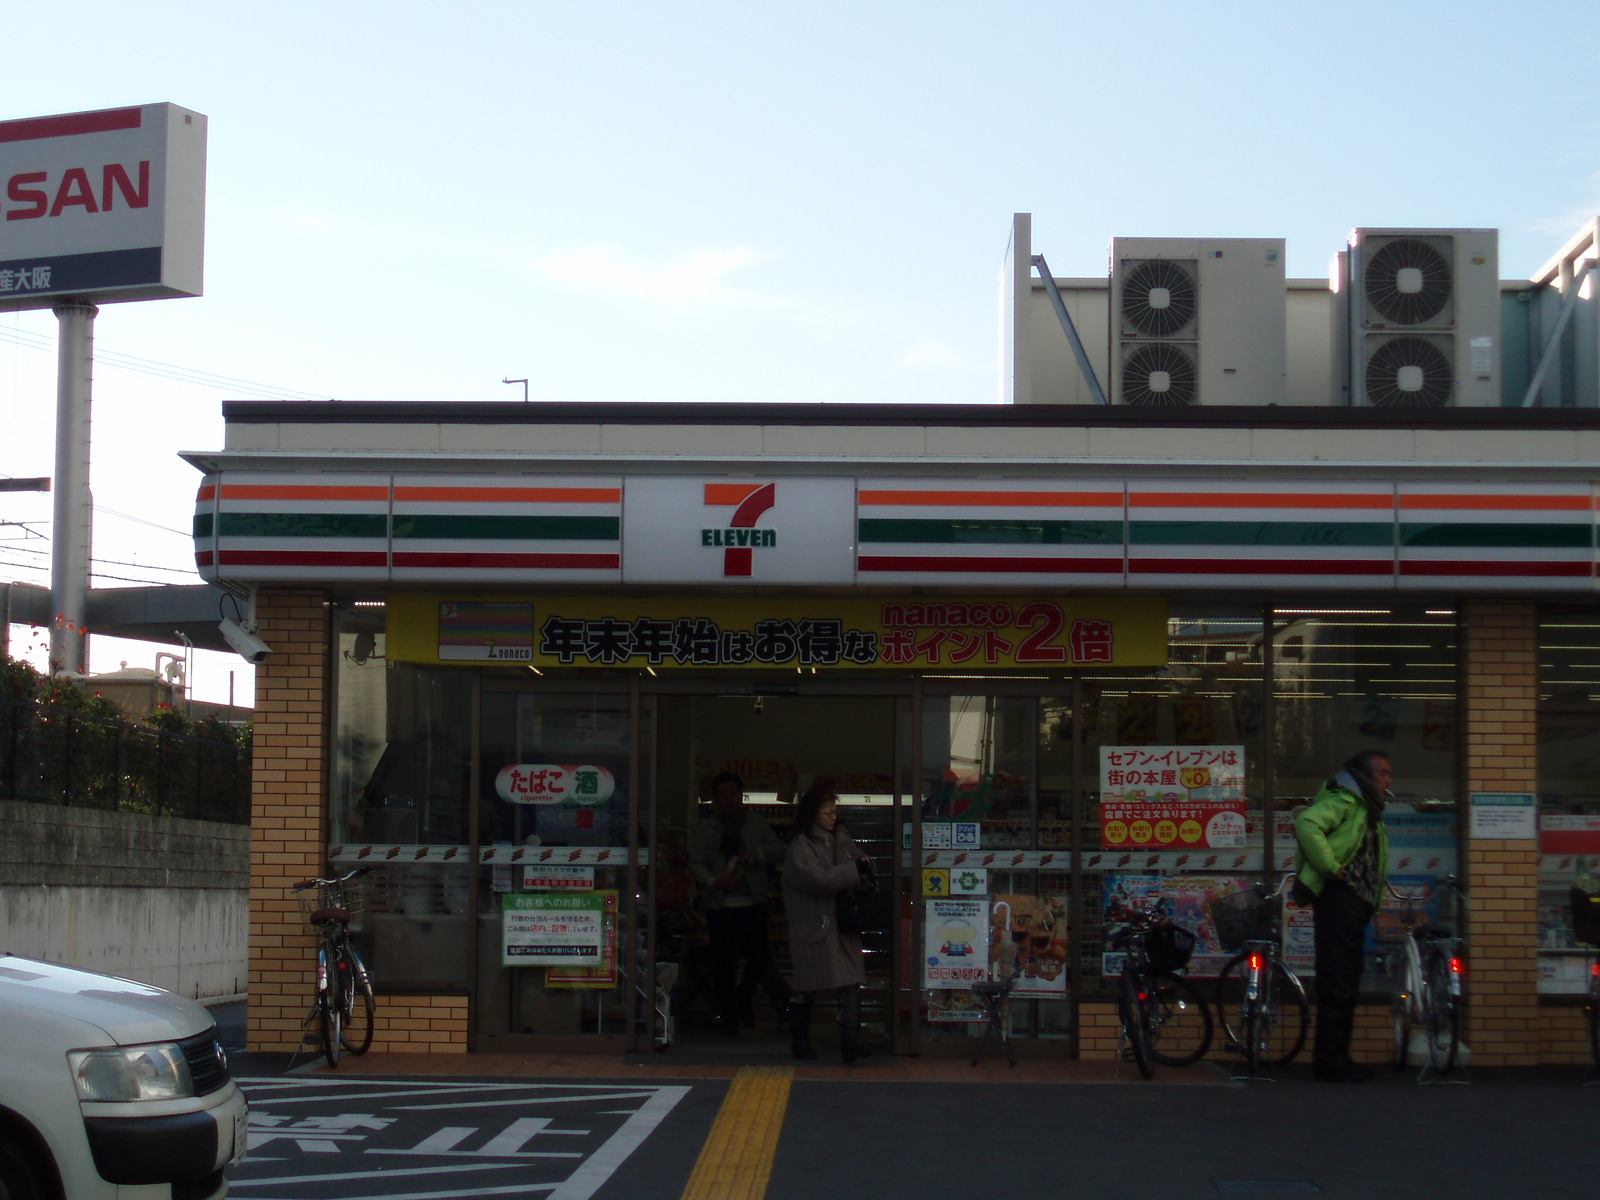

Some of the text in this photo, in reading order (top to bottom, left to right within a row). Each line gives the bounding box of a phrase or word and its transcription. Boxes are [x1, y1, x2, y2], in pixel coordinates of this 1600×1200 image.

[0, 160, 150, 221] SAN
[704, 482, 775, 576] 7
[882, 602, 1013, 627] nanaco
[541, 617, 876, 664] 年末年始はお得な
[881, 628, 1013, 664] ポイント
[498, 649, 530, 659] nanaco
[510, 770, 564, 793] たばこ
[575, 771, 598, 794] 酒
[1108, 770, 1177, 786] 街の本屋
